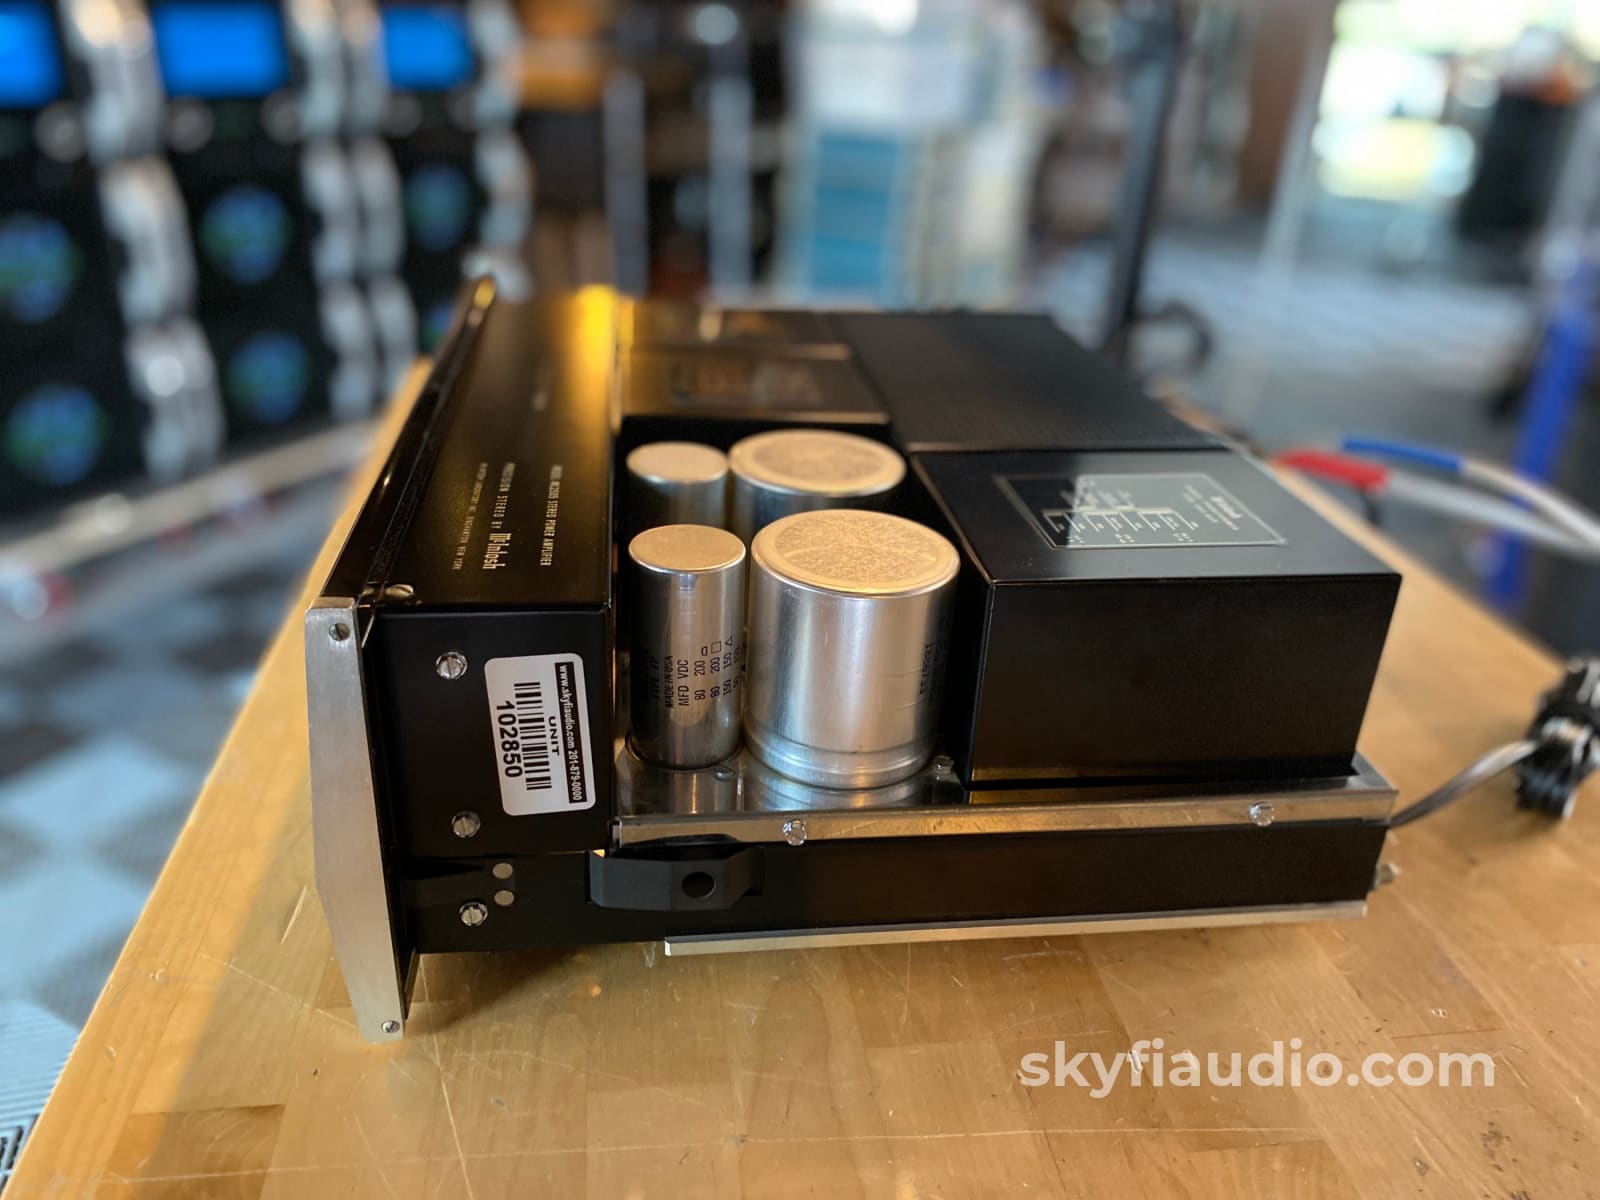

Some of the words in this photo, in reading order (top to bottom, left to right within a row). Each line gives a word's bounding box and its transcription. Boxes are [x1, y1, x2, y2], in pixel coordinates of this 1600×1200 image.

[493, 495, 508, 518] STEREO
[546, 500, 558, 518] STEREO
[490, 521, 503, 529] BY
[544, 519, 556, 537] POWER
[482, 533, 512, 569] McIntosh
[540, 538, 554, 566] AMPLIFIER
[664, 655, 673, 673] USA
[677, 659, 689, 680] VDC
[694, 660, 706, 676] 200
[710, 657, 720, 673] 200
[723, 652, 732, 669] 150
[664, 684, 674, 708] MADE
[678, 685, 690, 707] MFD
[694, 689, 706, 701] 80
[710, 686, 720, 698] 80
[723, 679, 731, 696] 150
[496, 700, 523, 778] 102850
[548, 716, 560, 755] UNIT
[559, 664, 576, 749] www.skyfiaudio.com
[568, 749, 582, 801] 201-879-0000
